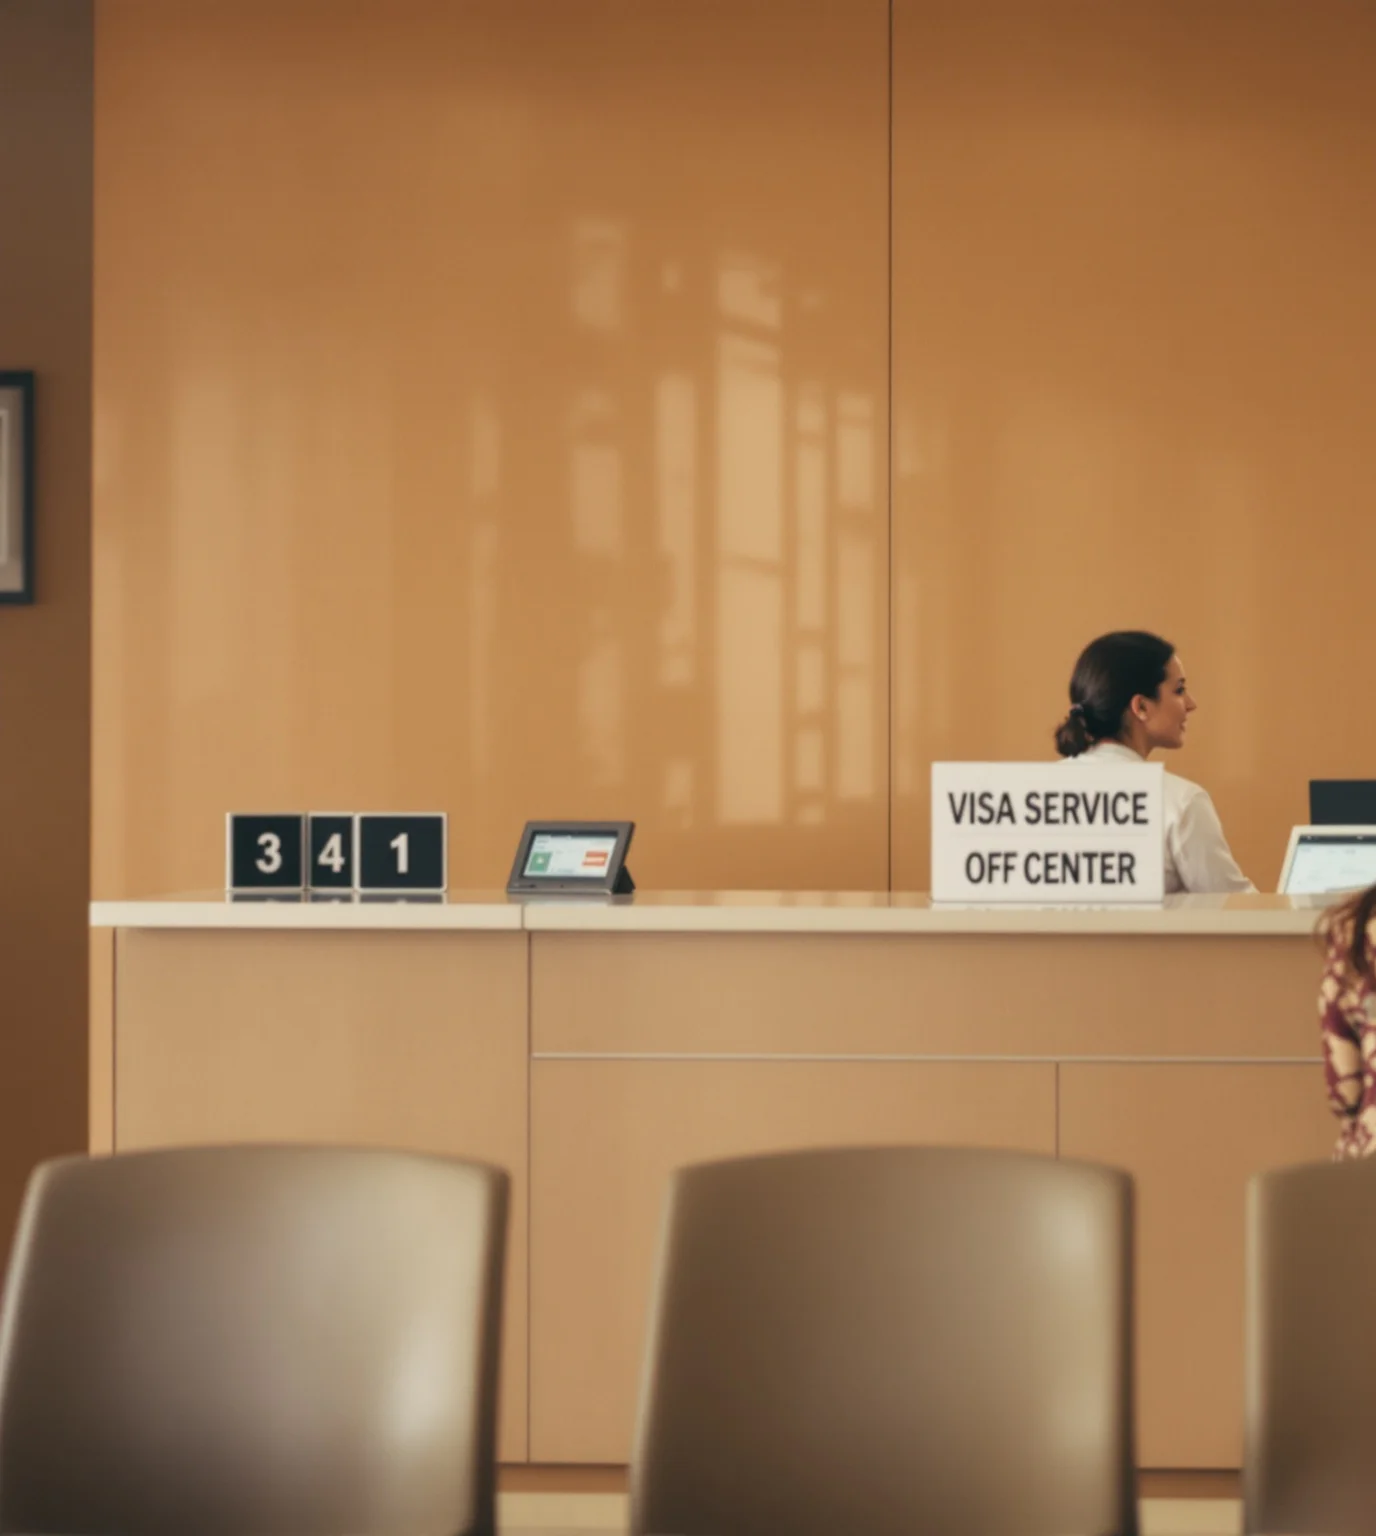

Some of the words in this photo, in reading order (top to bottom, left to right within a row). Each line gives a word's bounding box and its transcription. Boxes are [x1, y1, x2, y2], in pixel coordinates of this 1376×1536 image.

[948, 791, 1016, 825] VISA
[1024, 791, 1149, 825] SERVICE
[256, 832, 282, 874] 3
[317, 832, 345, 874] 4
[390, 832, 409, 874] 1
[965, 851, 1018, 885] OFF
[1023, 851, 1136, 885] CENTER
